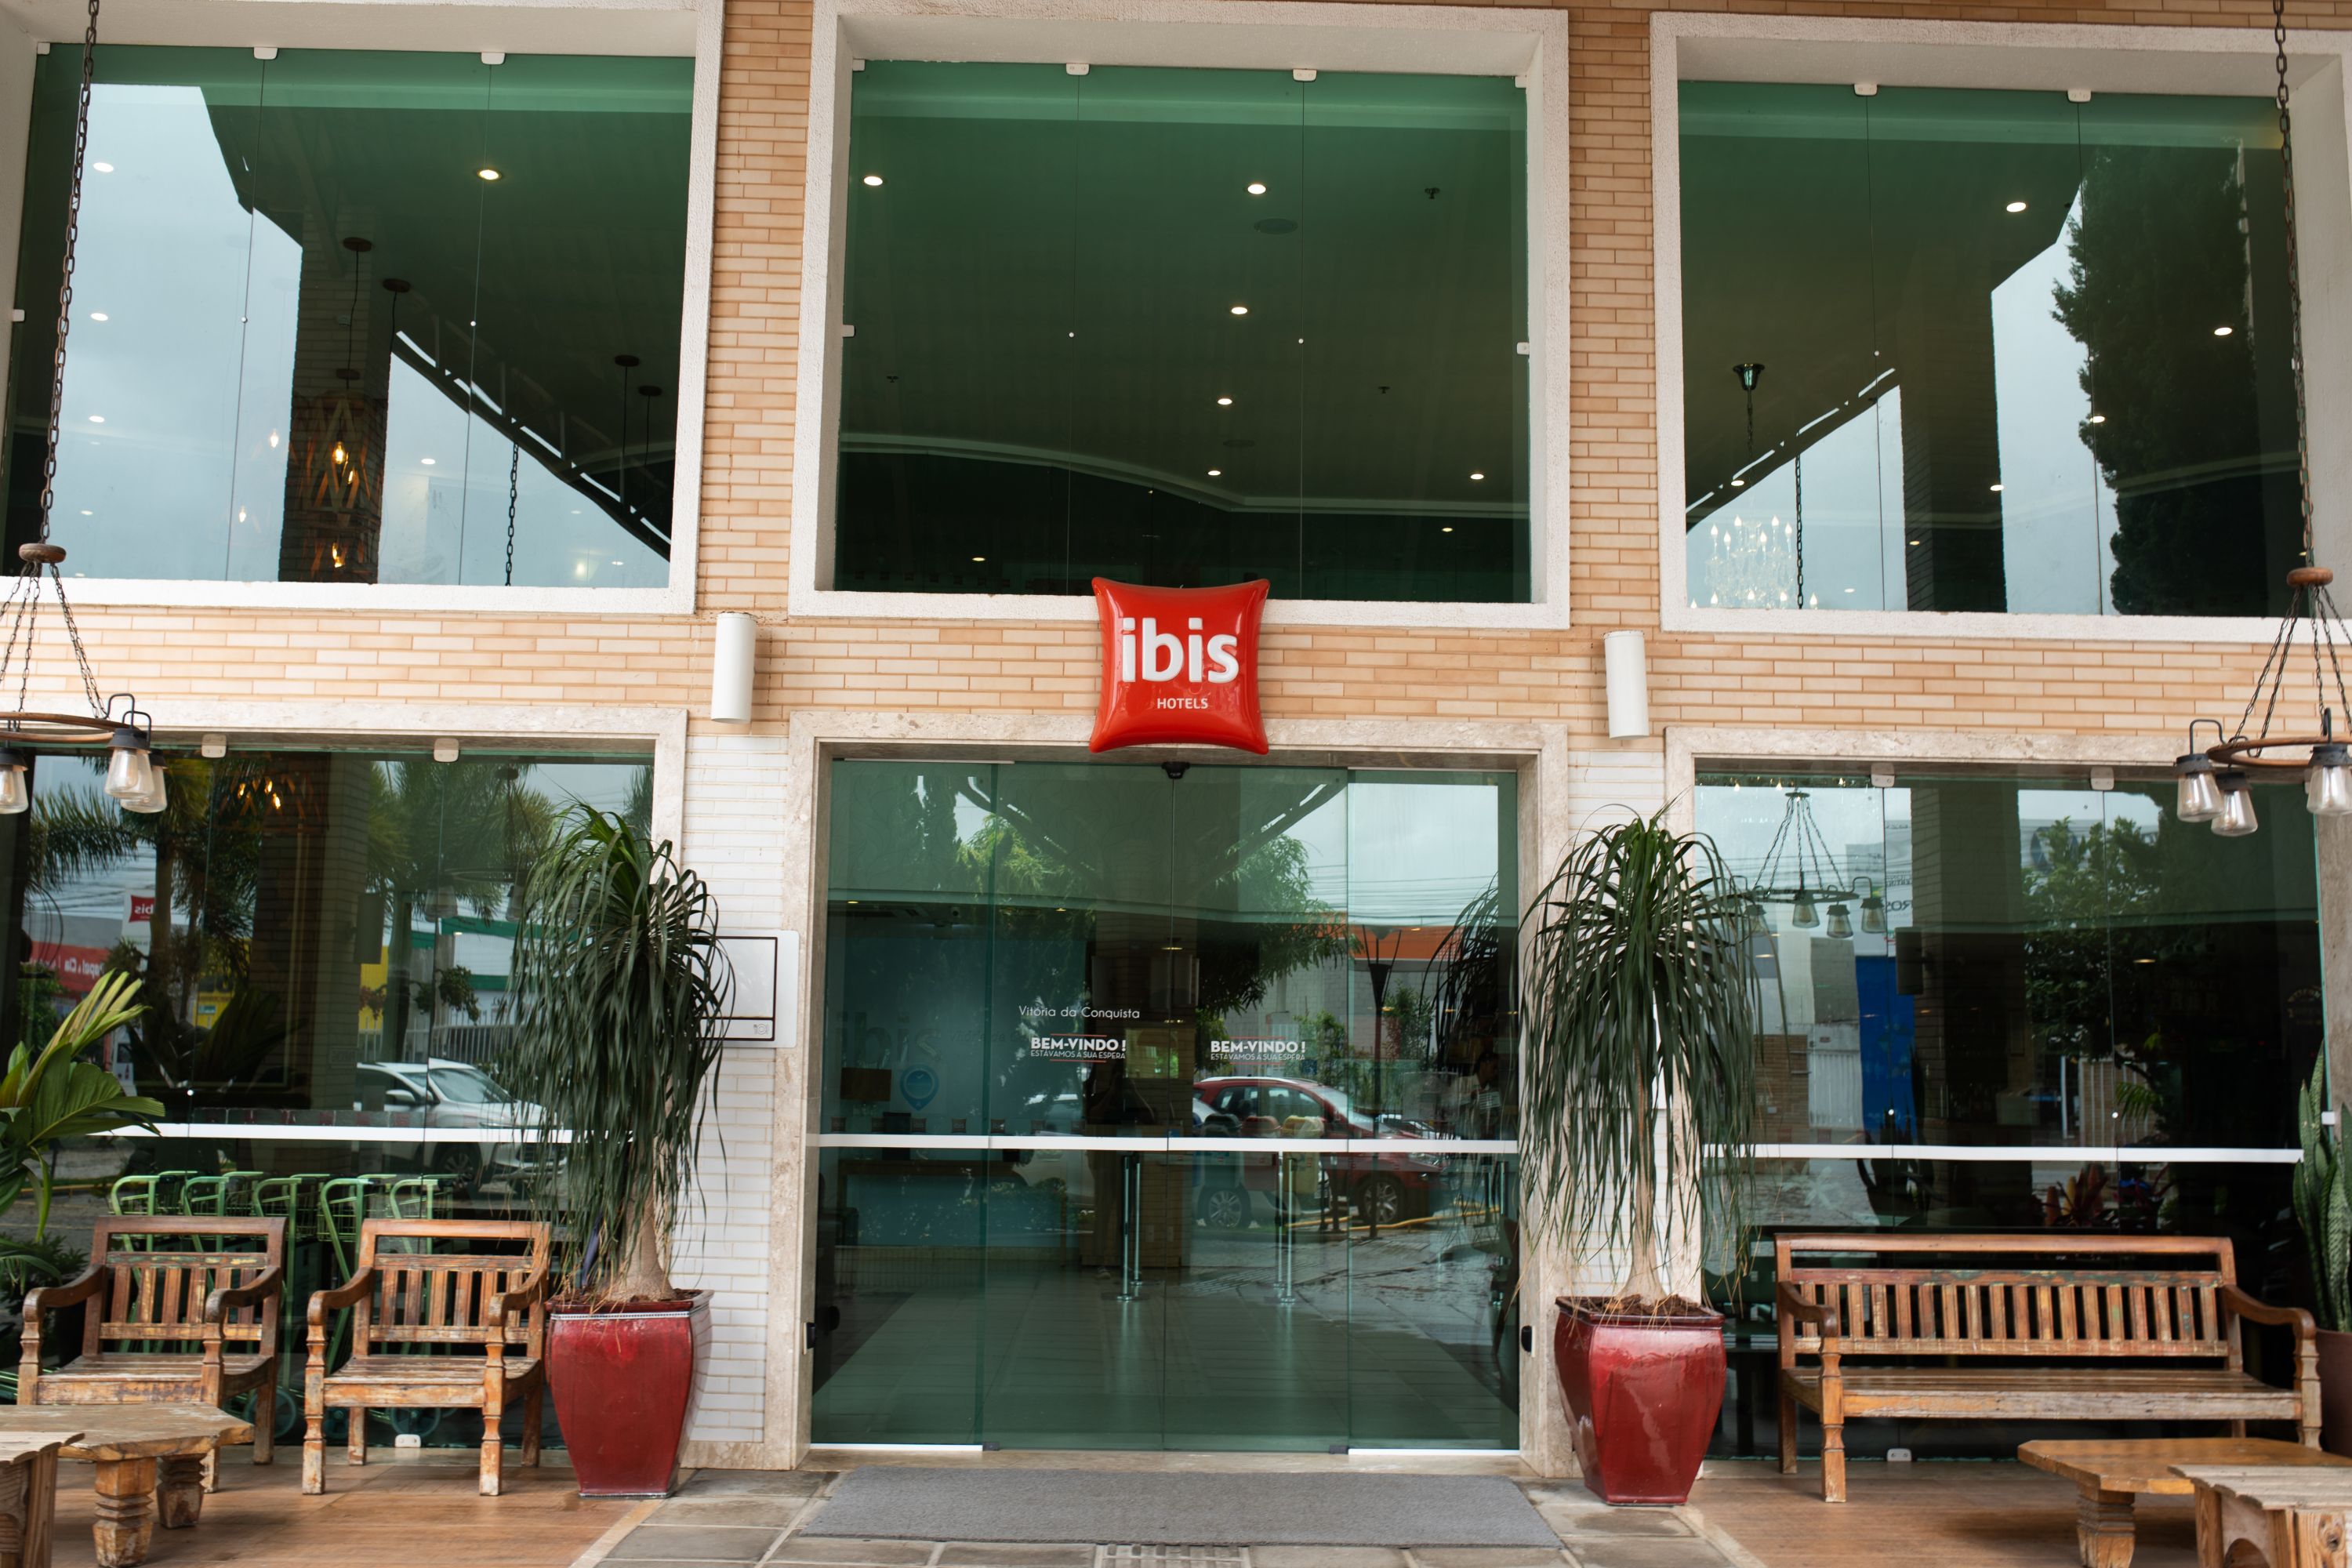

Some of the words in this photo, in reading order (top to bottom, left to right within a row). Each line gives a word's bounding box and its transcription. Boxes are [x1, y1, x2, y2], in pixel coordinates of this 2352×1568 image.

[1122, 617, 1240, 684] ibis
[1156, 697, 1209, 710] HOTELS
[1018, 1005, 1056, 1017] Vitória
[1060, 1006, 1077, 1017] da
[1080, 1006, 1140, 1020] Conquista
[1263, 1052, 1277, 1061] SUA
